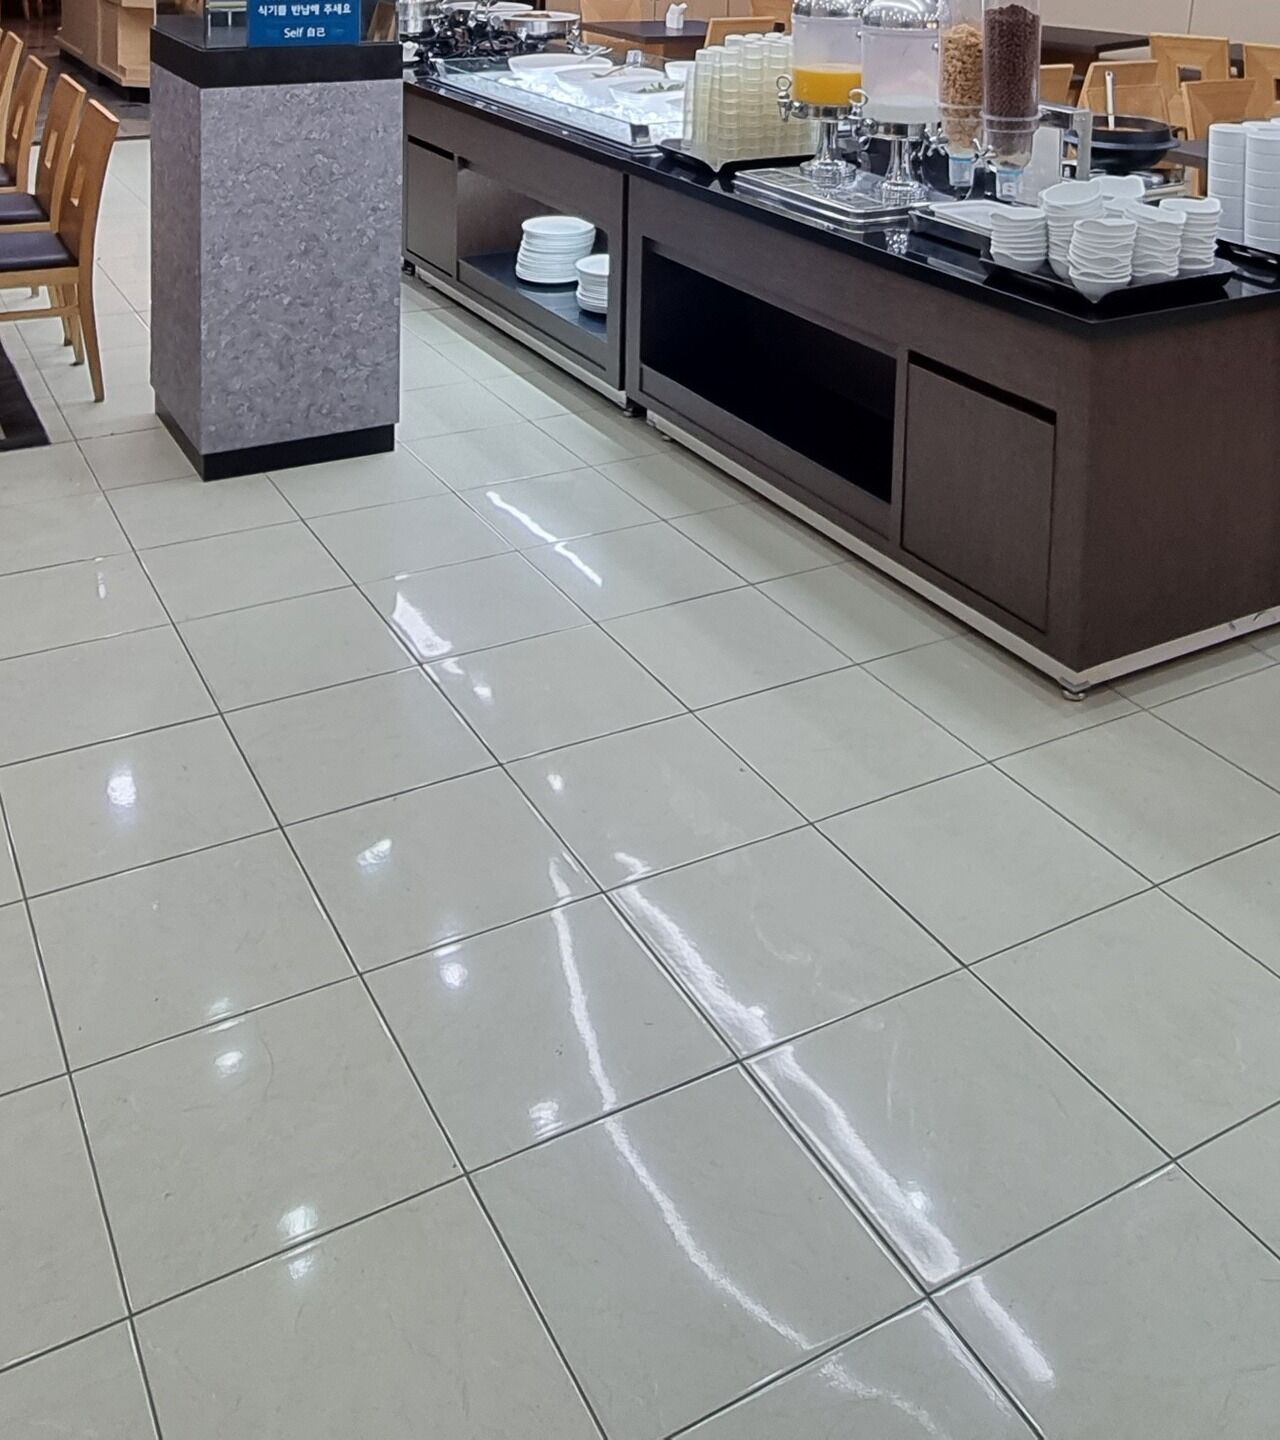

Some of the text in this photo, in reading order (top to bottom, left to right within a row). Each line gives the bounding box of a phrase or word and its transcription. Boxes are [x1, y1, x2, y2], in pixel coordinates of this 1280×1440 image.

[258, 5, 287, 16] 식기를
[323, 3, 352, 15] 주세요
[283, 27, 326, 38] Self 自己
